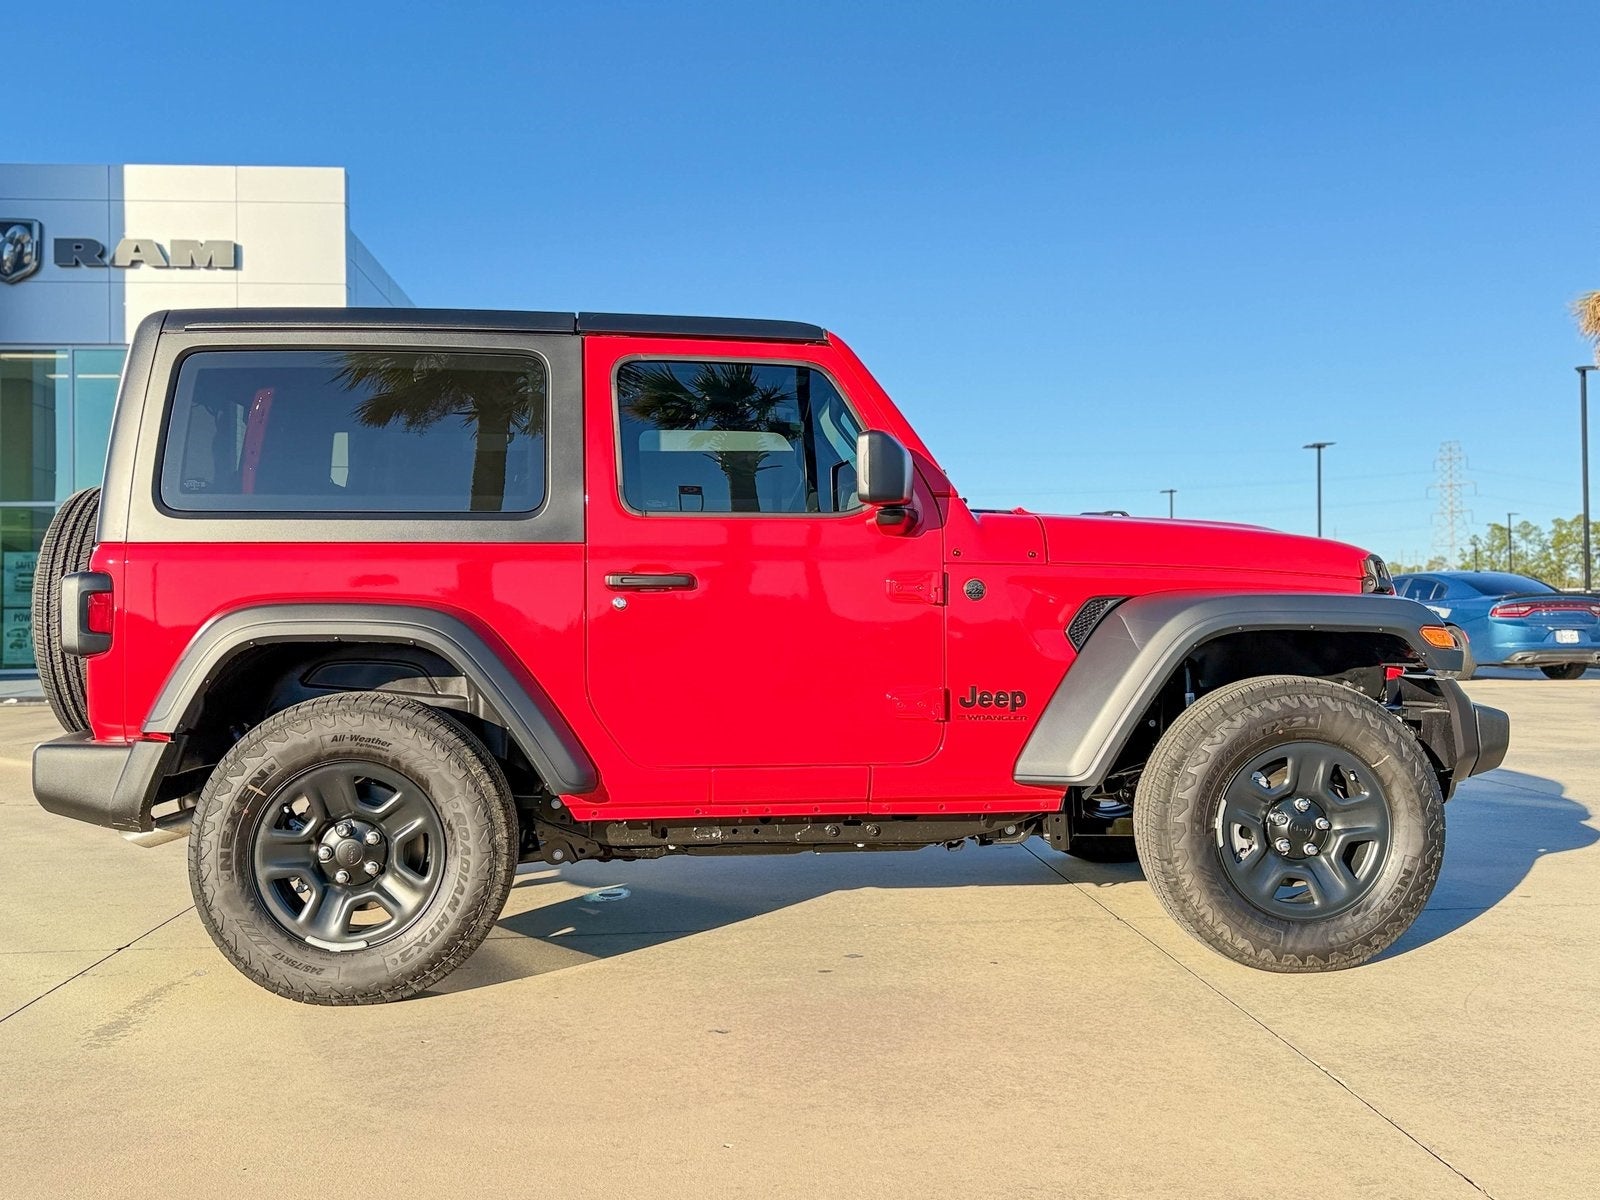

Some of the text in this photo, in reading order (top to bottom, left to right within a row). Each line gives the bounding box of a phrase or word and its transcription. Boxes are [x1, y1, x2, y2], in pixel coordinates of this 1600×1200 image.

[54, 238, 238, 269] RAM
[959, 686, 1026, 712] Jeep
[331, 734, 393, 748] All-Weather
[220, 768, 270, 872] NEXEN
[400, 811, 472, 963] ROADIAN HTX2
[271, 952, 325, 976] 245/75R17
